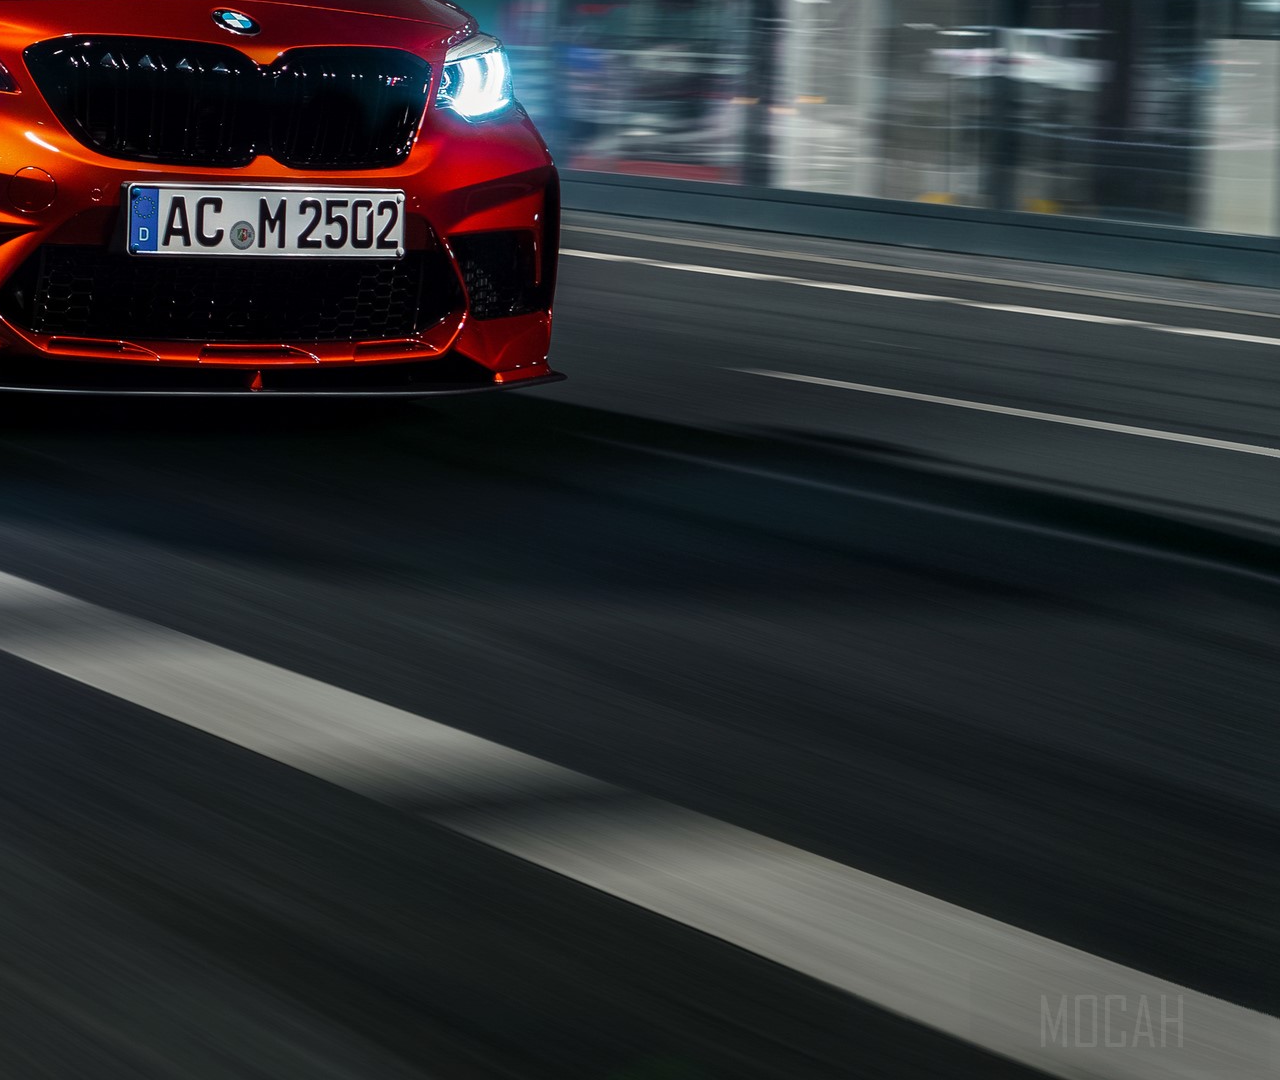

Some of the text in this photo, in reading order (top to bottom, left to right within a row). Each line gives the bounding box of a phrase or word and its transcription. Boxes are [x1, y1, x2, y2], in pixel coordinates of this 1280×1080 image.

[139, 227, 149, 241] D
[162, 196, 225, 247] AC
[257, 197, 287, 249] M
[297, 198, 399, 250] 2502
